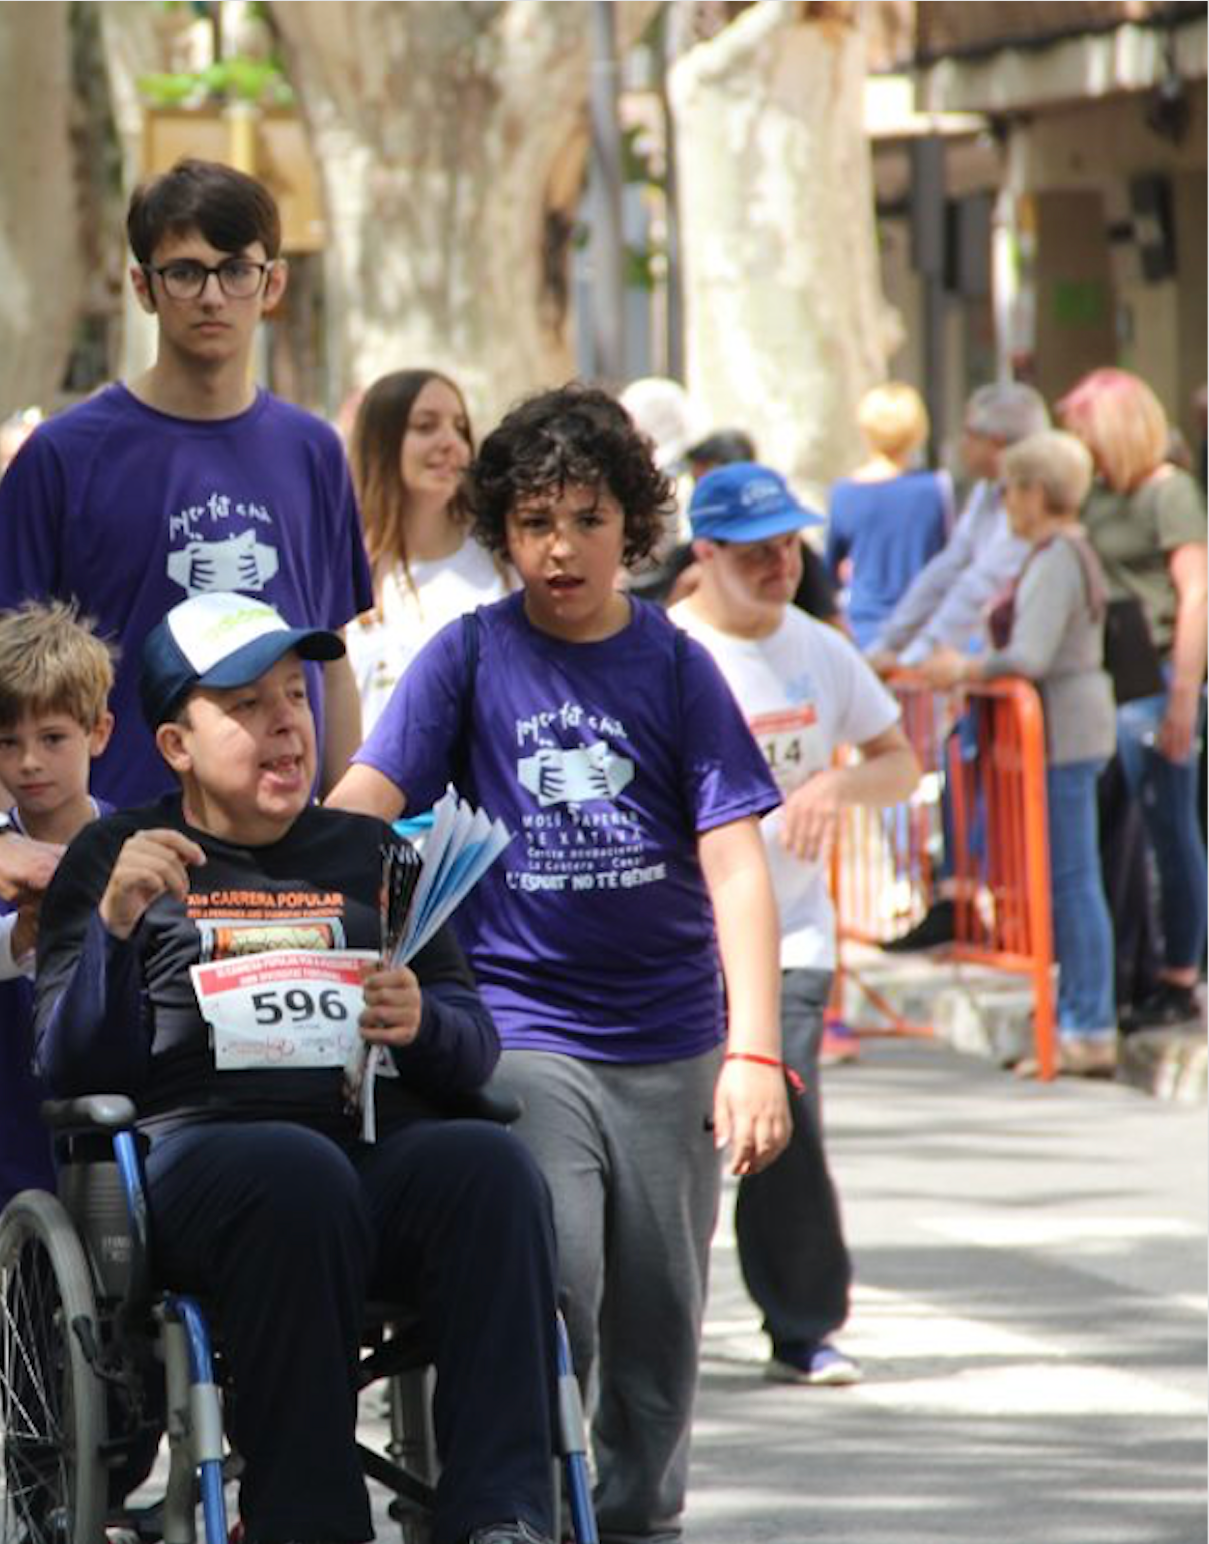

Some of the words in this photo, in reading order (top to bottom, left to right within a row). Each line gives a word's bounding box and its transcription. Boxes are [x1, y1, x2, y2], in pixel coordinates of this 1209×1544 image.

[571, 871, 594, 892] NO
[210, 890, 276, 908] CARRERA
[277, 891, 344, 909] POPULAR
[251, 989, 348, 1026] 596
